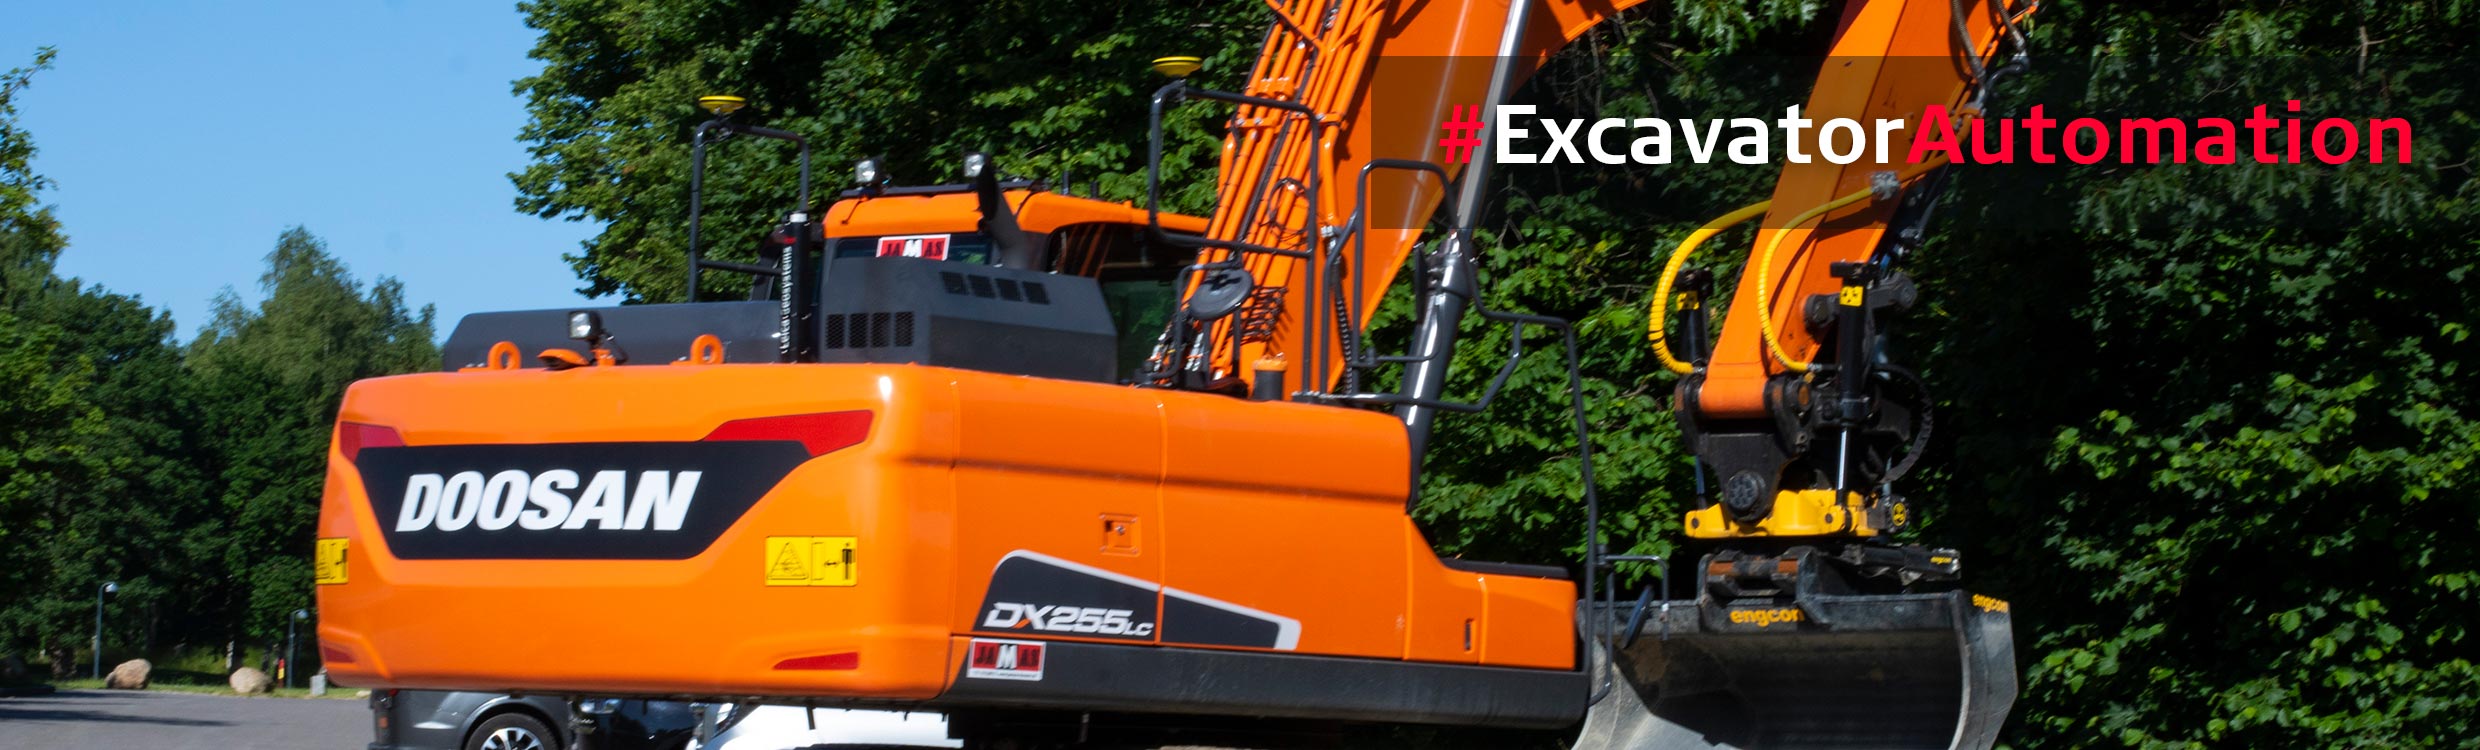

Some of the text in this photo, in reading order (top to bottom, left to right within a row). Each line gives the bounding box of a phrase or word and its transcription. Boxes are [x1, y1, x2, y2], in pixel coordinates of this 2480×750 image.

[881, 239, 945, 258] JAMAS
[395, 469, 703, 532] DOOSAN
[1972, 593, 2010, 613] engcon
[1729, 608, 1805, 627] engcon
[975, 643, 1041, 669] JAMAS
